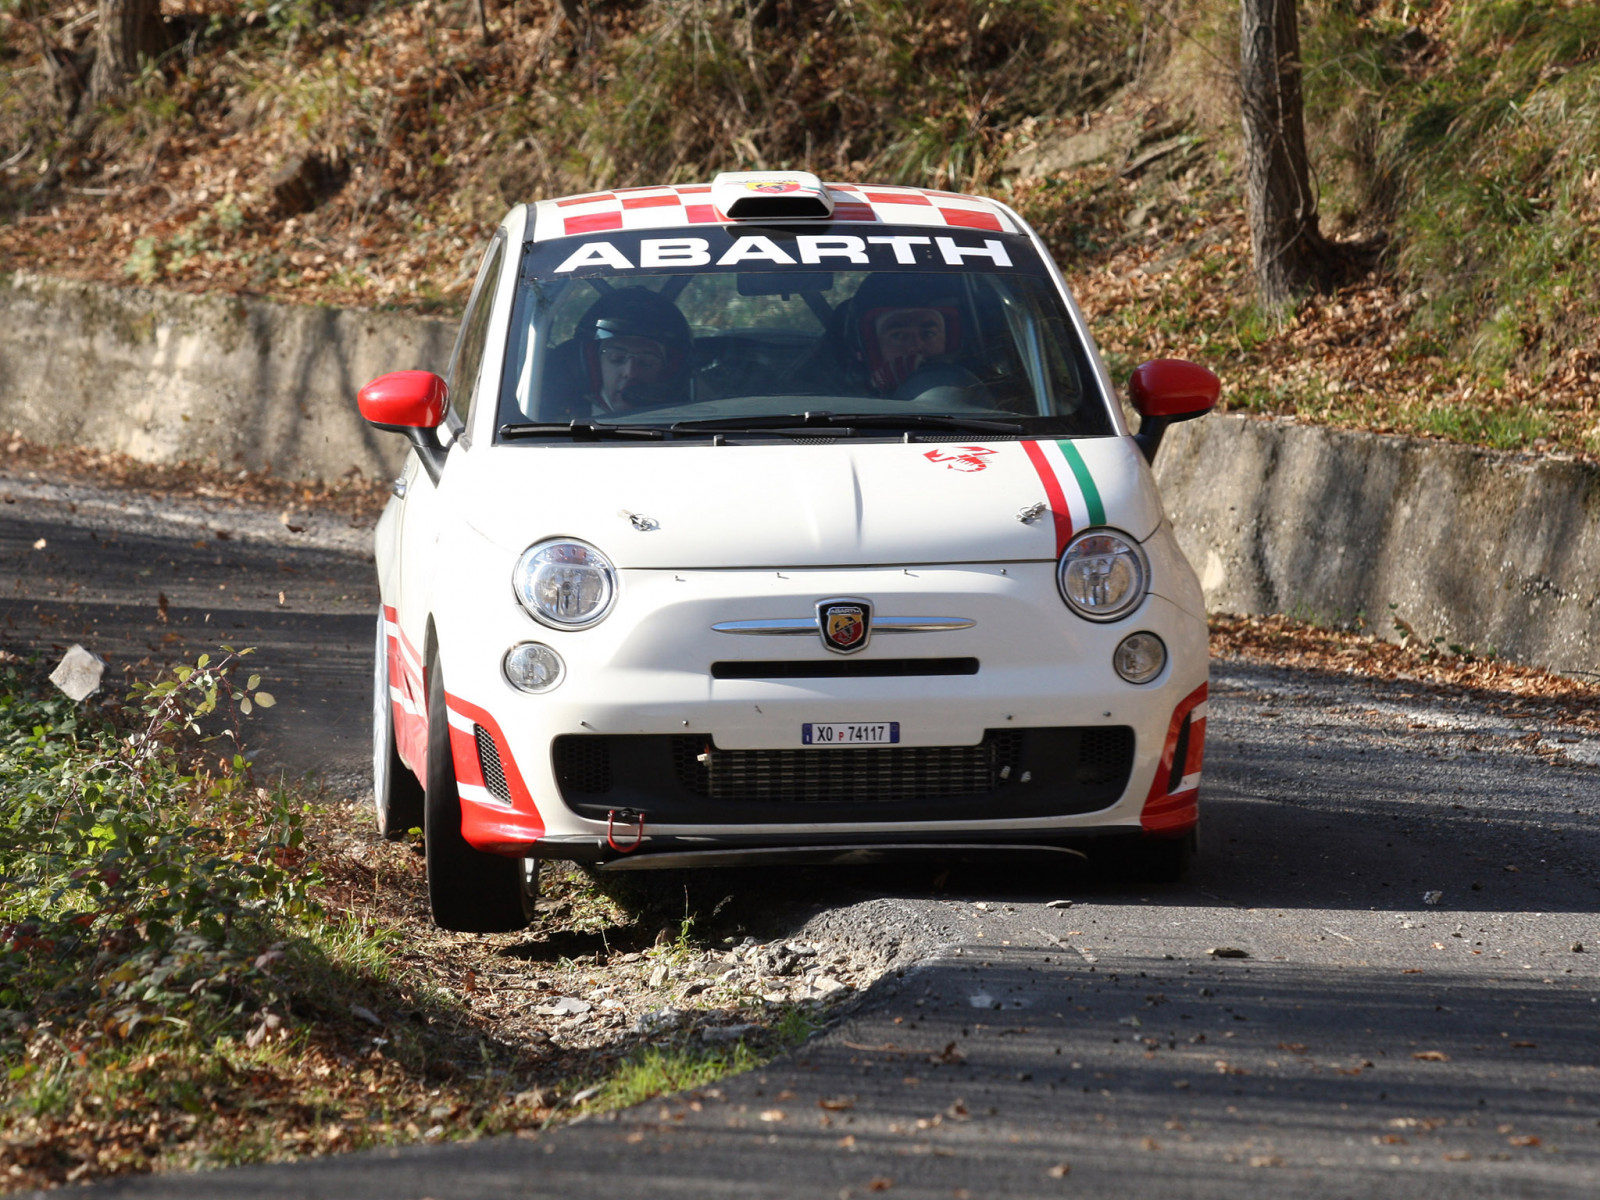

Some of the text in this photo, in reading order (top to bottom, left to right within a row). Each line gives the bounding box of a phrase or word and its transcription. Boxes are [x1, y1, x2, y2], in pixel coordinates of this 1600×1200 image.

[553, 235, 1013, 273] ABARTH
[838, 731, 845, 741] P
[848, 726, 884, 742] 74117
